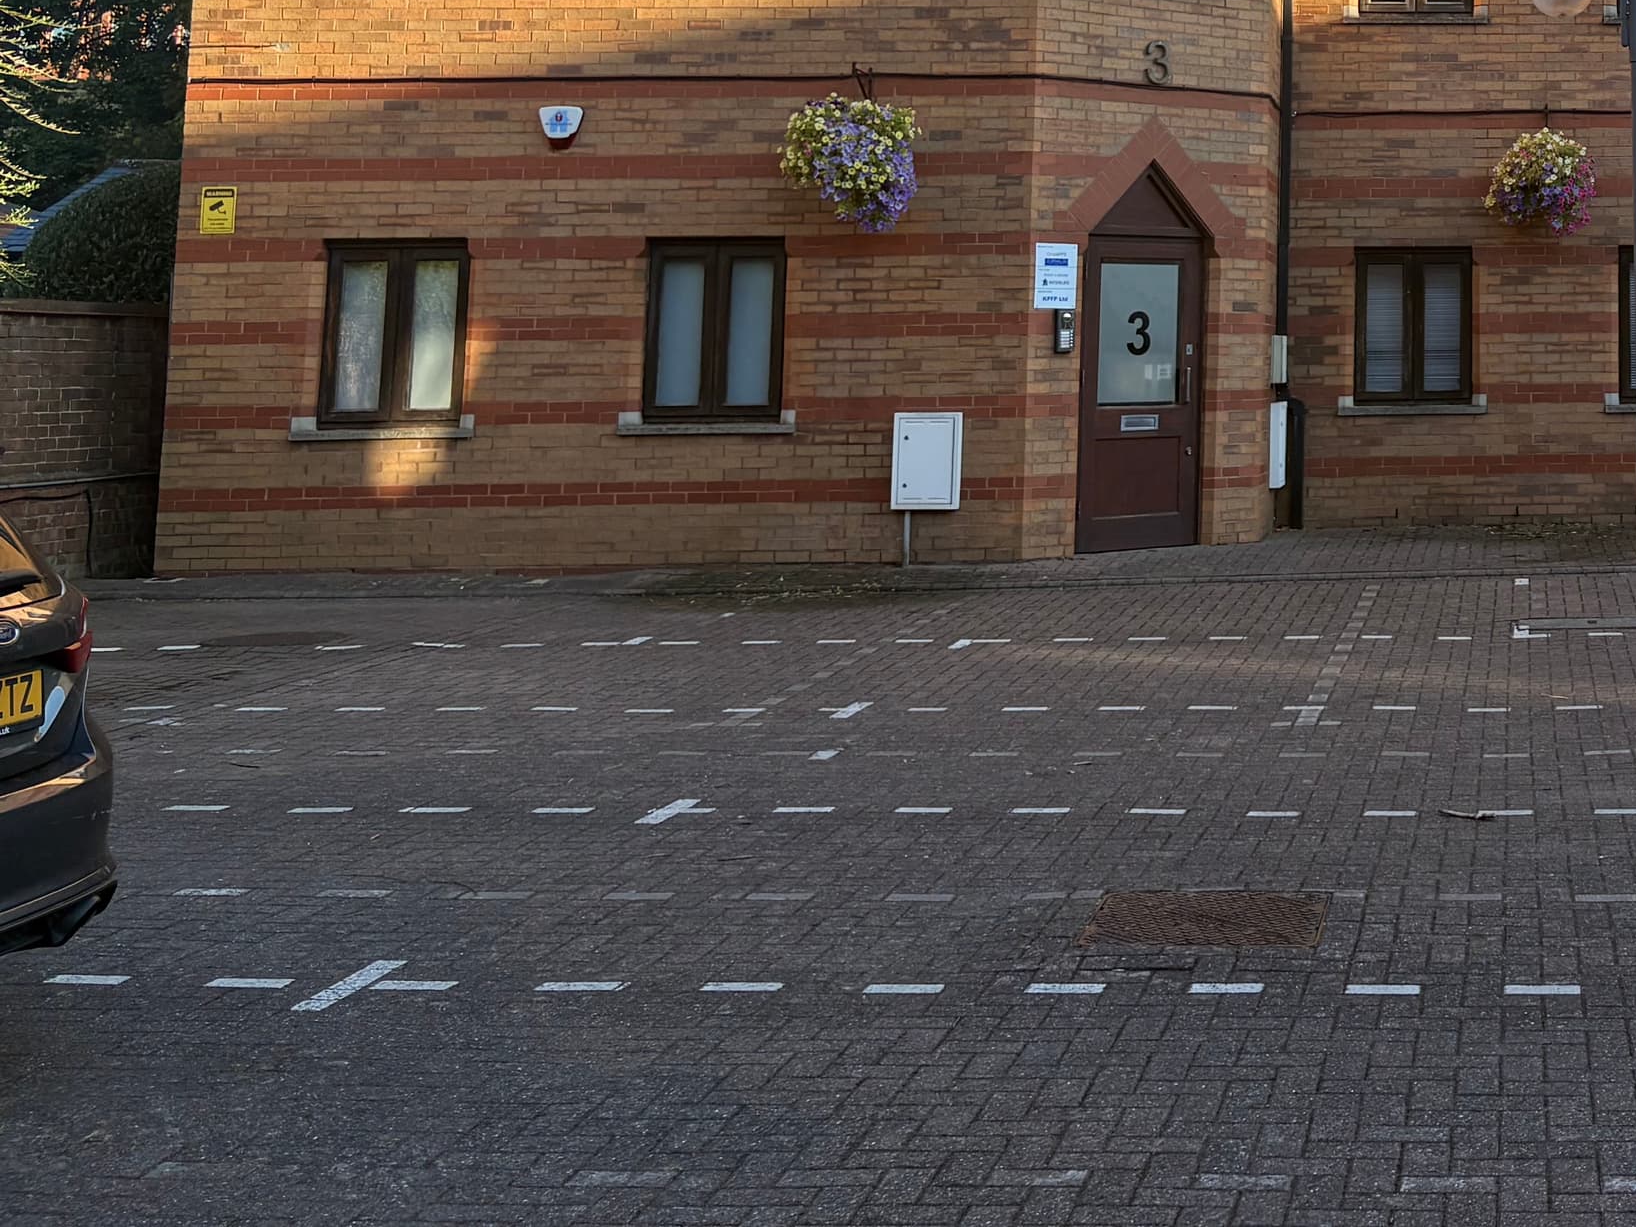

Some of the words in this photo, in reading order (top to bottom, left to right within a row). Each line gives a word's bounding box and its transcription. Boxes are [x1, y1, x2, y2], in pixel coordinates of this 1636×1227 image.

[1143, 40, 1169, 85] 3
[1126, 311, 1151, 356] 3
[0, 674, 34, 719] TZ
